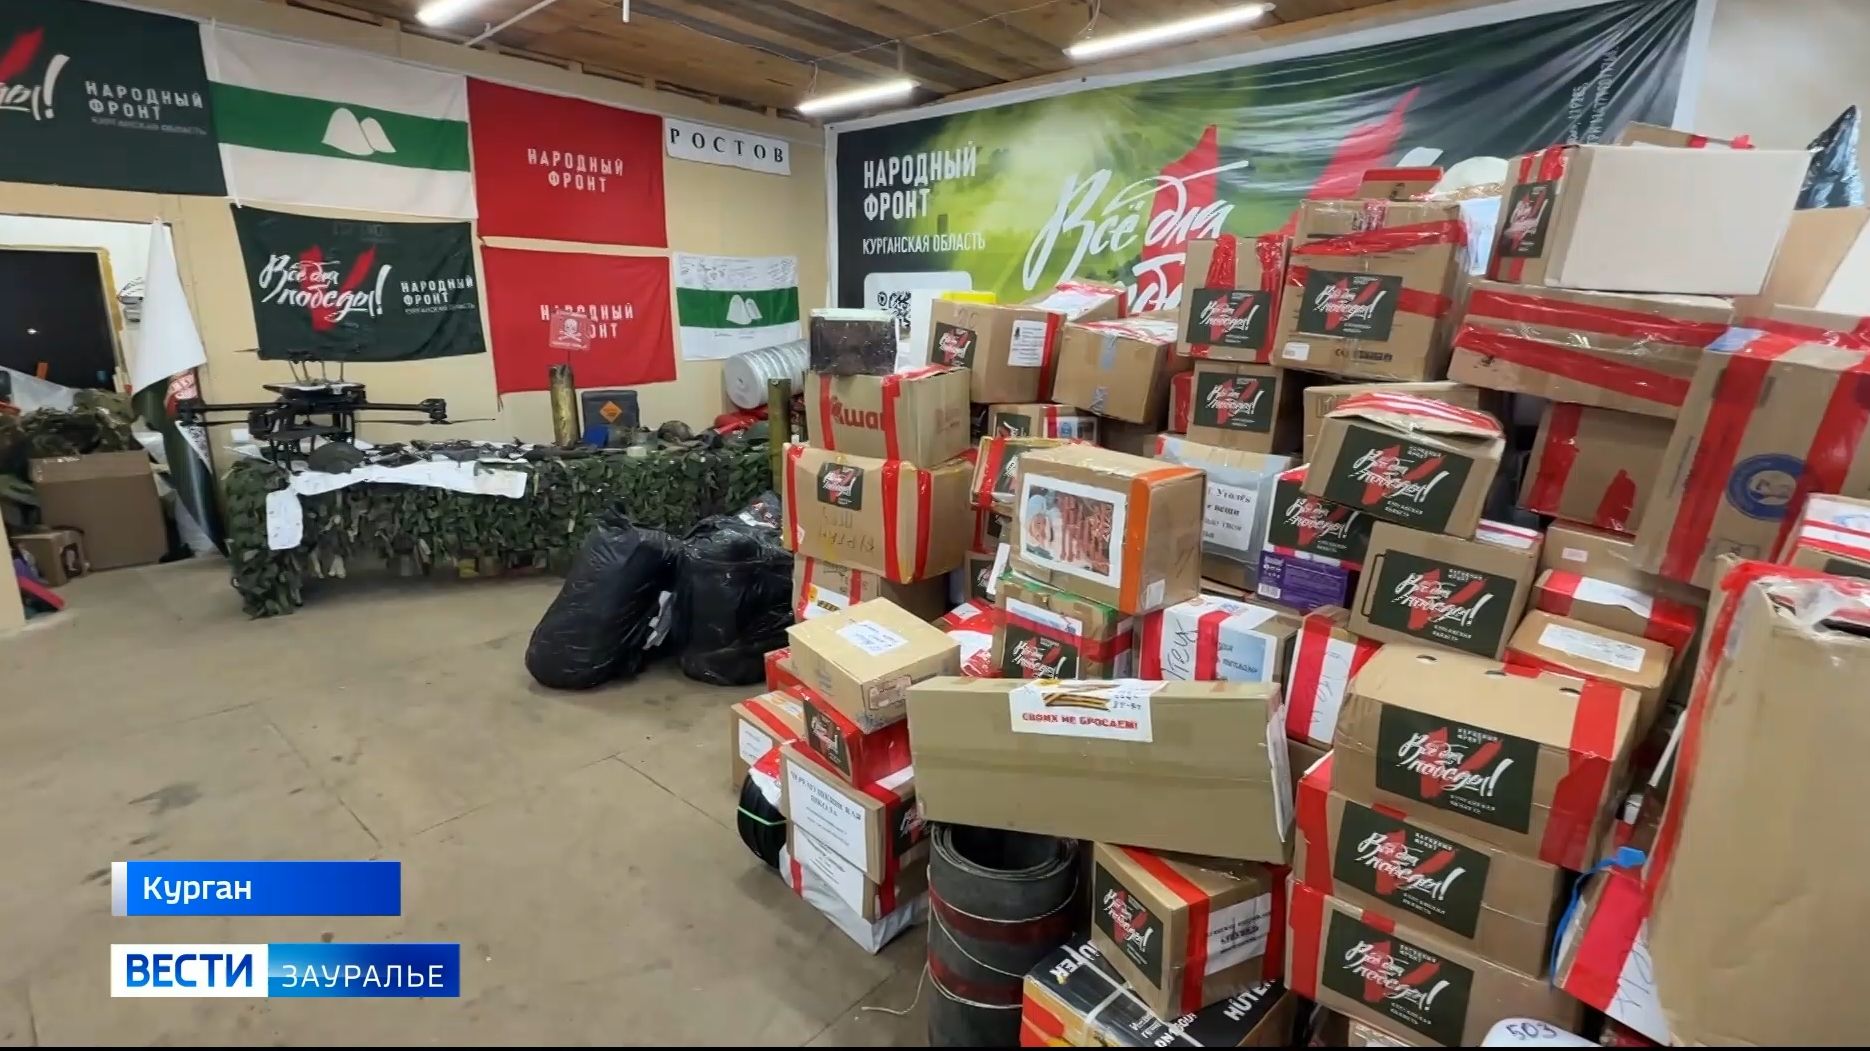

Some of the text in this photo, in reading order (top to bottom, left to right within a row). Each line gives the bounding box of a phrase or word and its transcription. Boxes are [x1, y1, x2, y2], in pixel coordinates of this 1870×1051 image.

[86, 80, 204, 109] НАРОДНЫЙ
[88, 98, 160, 121] ФРОНТ
[670, 127, 784, 163] РОСТОВ
[527, 148, 624, 177] НАРОДНЫЙ
[862, 141, 978, 189] НАРОДНЫЙ
[548, 169, 607, 193] ФРОНТ
[863, 188, 931, 221] ФРОНТ
[1022, 168, 1144, 290] Всё
[1102, 160, 1250, 250] для
[862, 232, 987, 255] КУРГАНСКАЯ ОБЛАСТЬ
[276, 264, 392, 323] победы!
[400, 275, 474, 293] НАРОДНЫЙ
[403, 292, 448, 306] ФРОНТ
[1022, 712, 1138, 730] СВОИХ НЕ БРОСАЕМ!
[1506, 1021, 1559, 1041] 503
